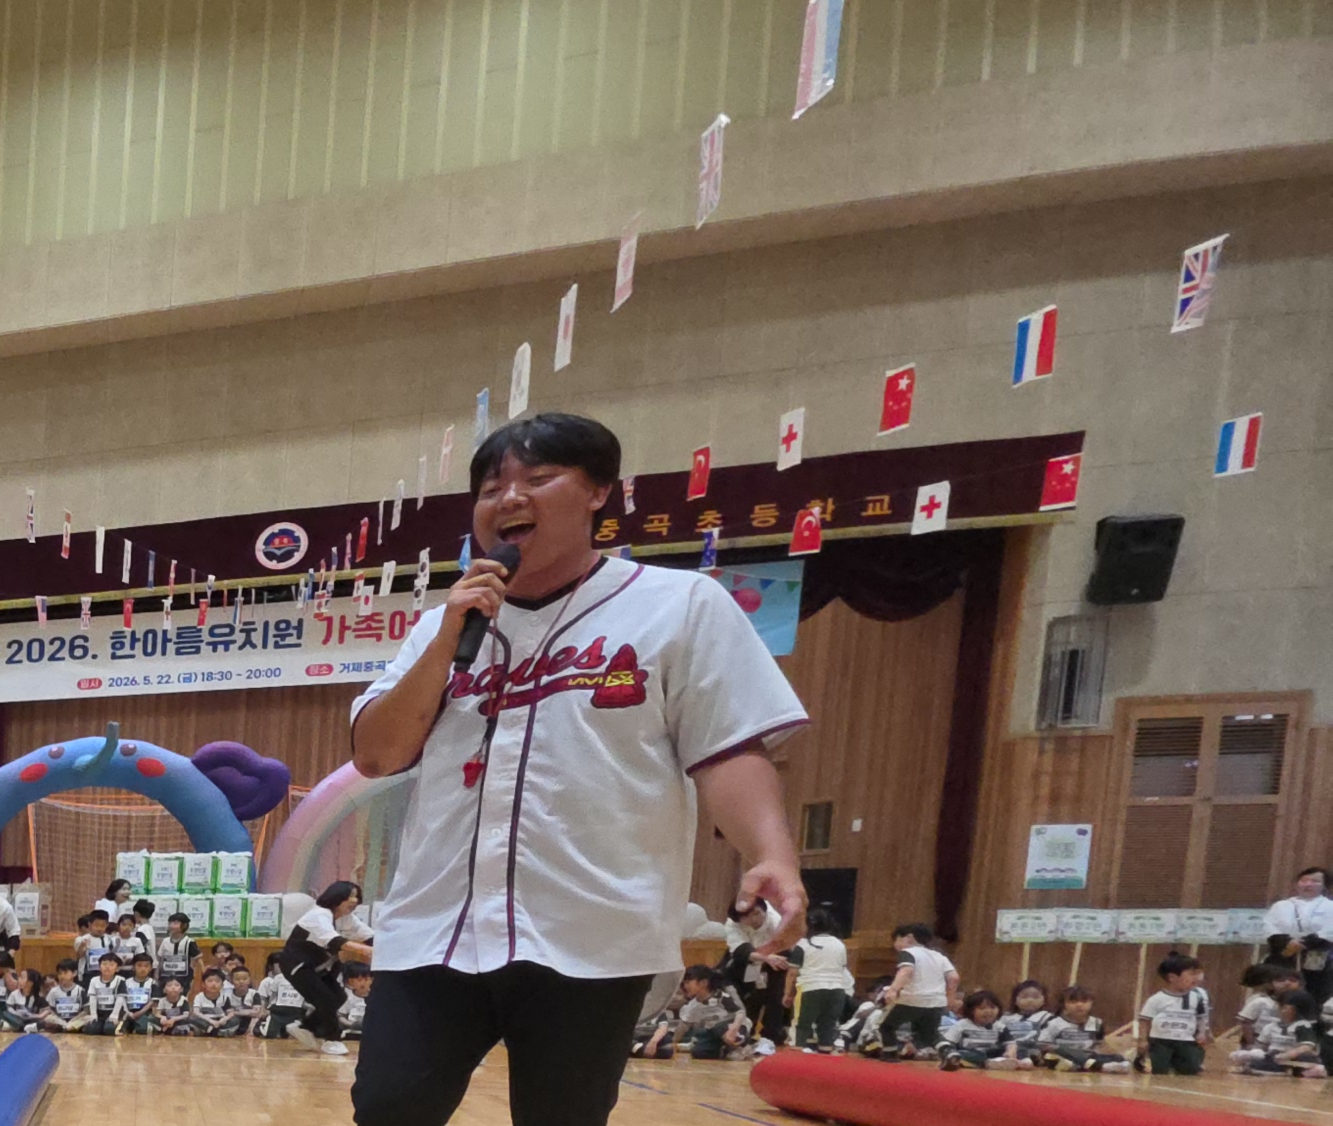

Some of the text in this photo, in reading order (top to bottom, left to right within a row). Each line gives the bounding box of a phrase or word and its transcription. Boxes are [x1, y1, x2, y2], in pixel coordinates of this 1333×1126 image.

[5, 634, 98, 664] 2026.
[109, 617, 304, 661] 한아름유치원
[107, 676, 140, 687] 2026.
[143, 675, 153, 686] 5.
[201, 670, 233, 682] 18:30
[245, 667, 282, 680] 20:00
[339, 659, 394, 674] 거제중곡
[445, 635, 607, 698] raves
